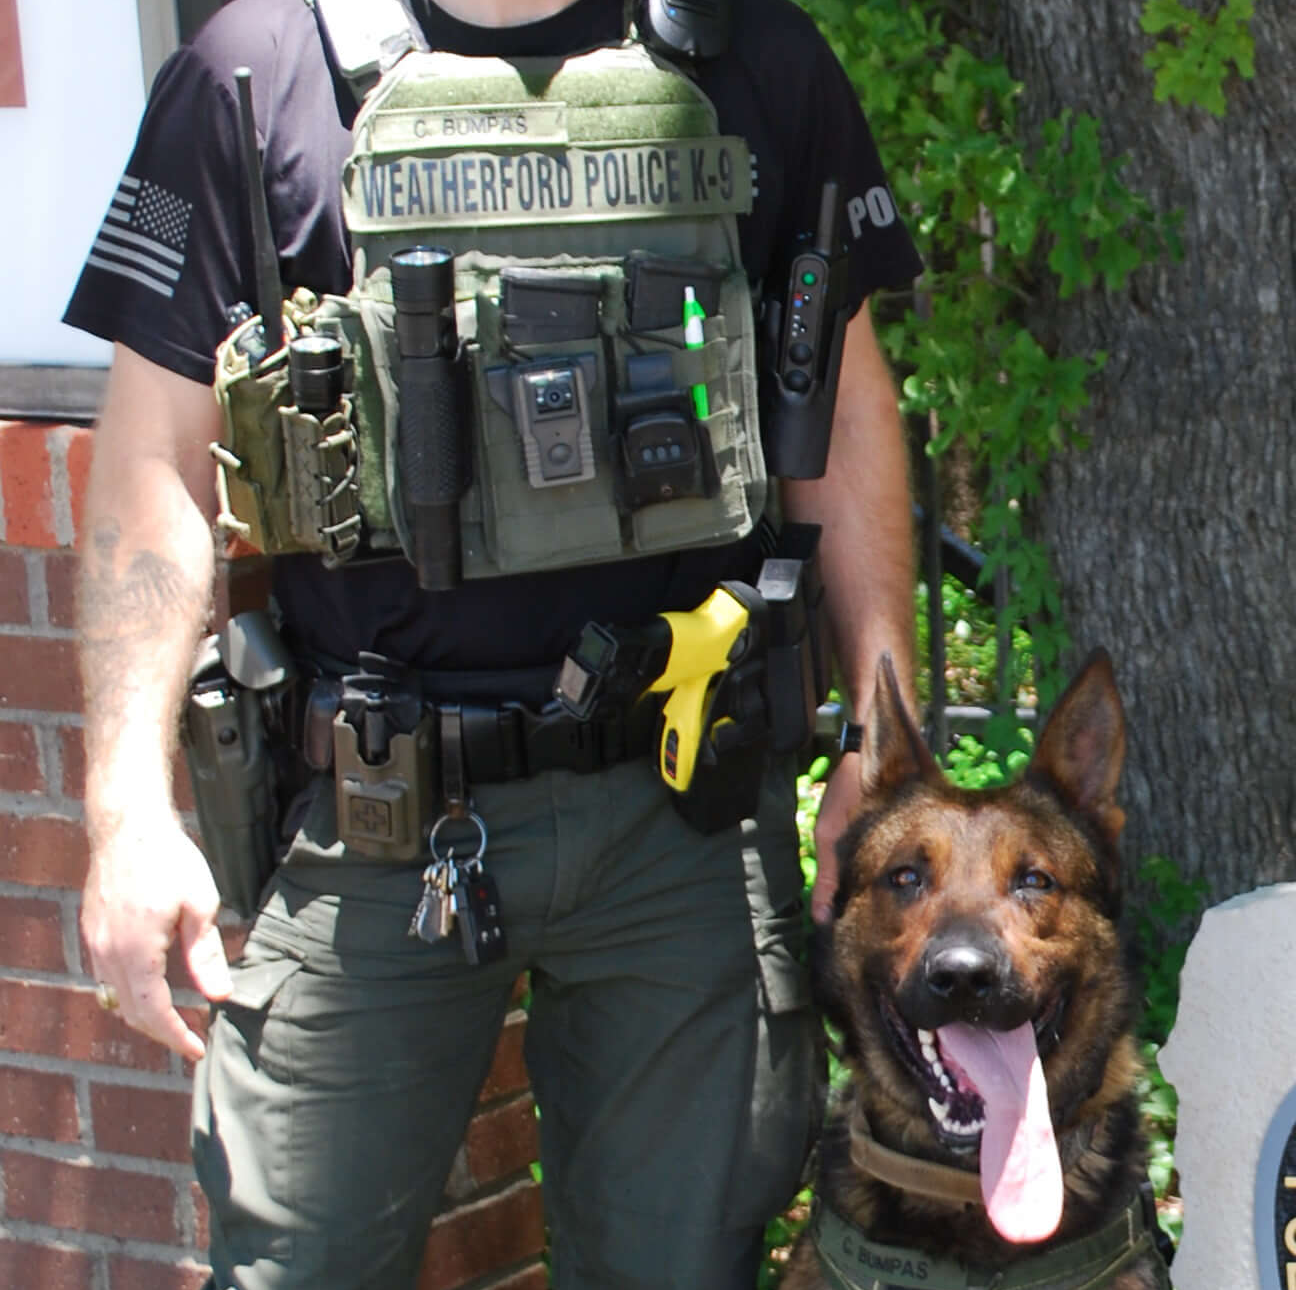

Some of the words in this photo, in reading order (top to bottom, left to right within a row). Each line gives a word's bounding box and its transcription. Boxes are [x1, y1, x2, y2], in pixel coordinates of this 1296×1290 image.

[443, 113, 529, 136] BUMPAS
[362, 154, 573, 217] WEATHERFORD
[585, 149, 681, 209] POLICE
[689, 146, 735, 202] K-9
[847, 185, 896, 240] PO
[858, 1246, 928, 1280] BUMPAS
